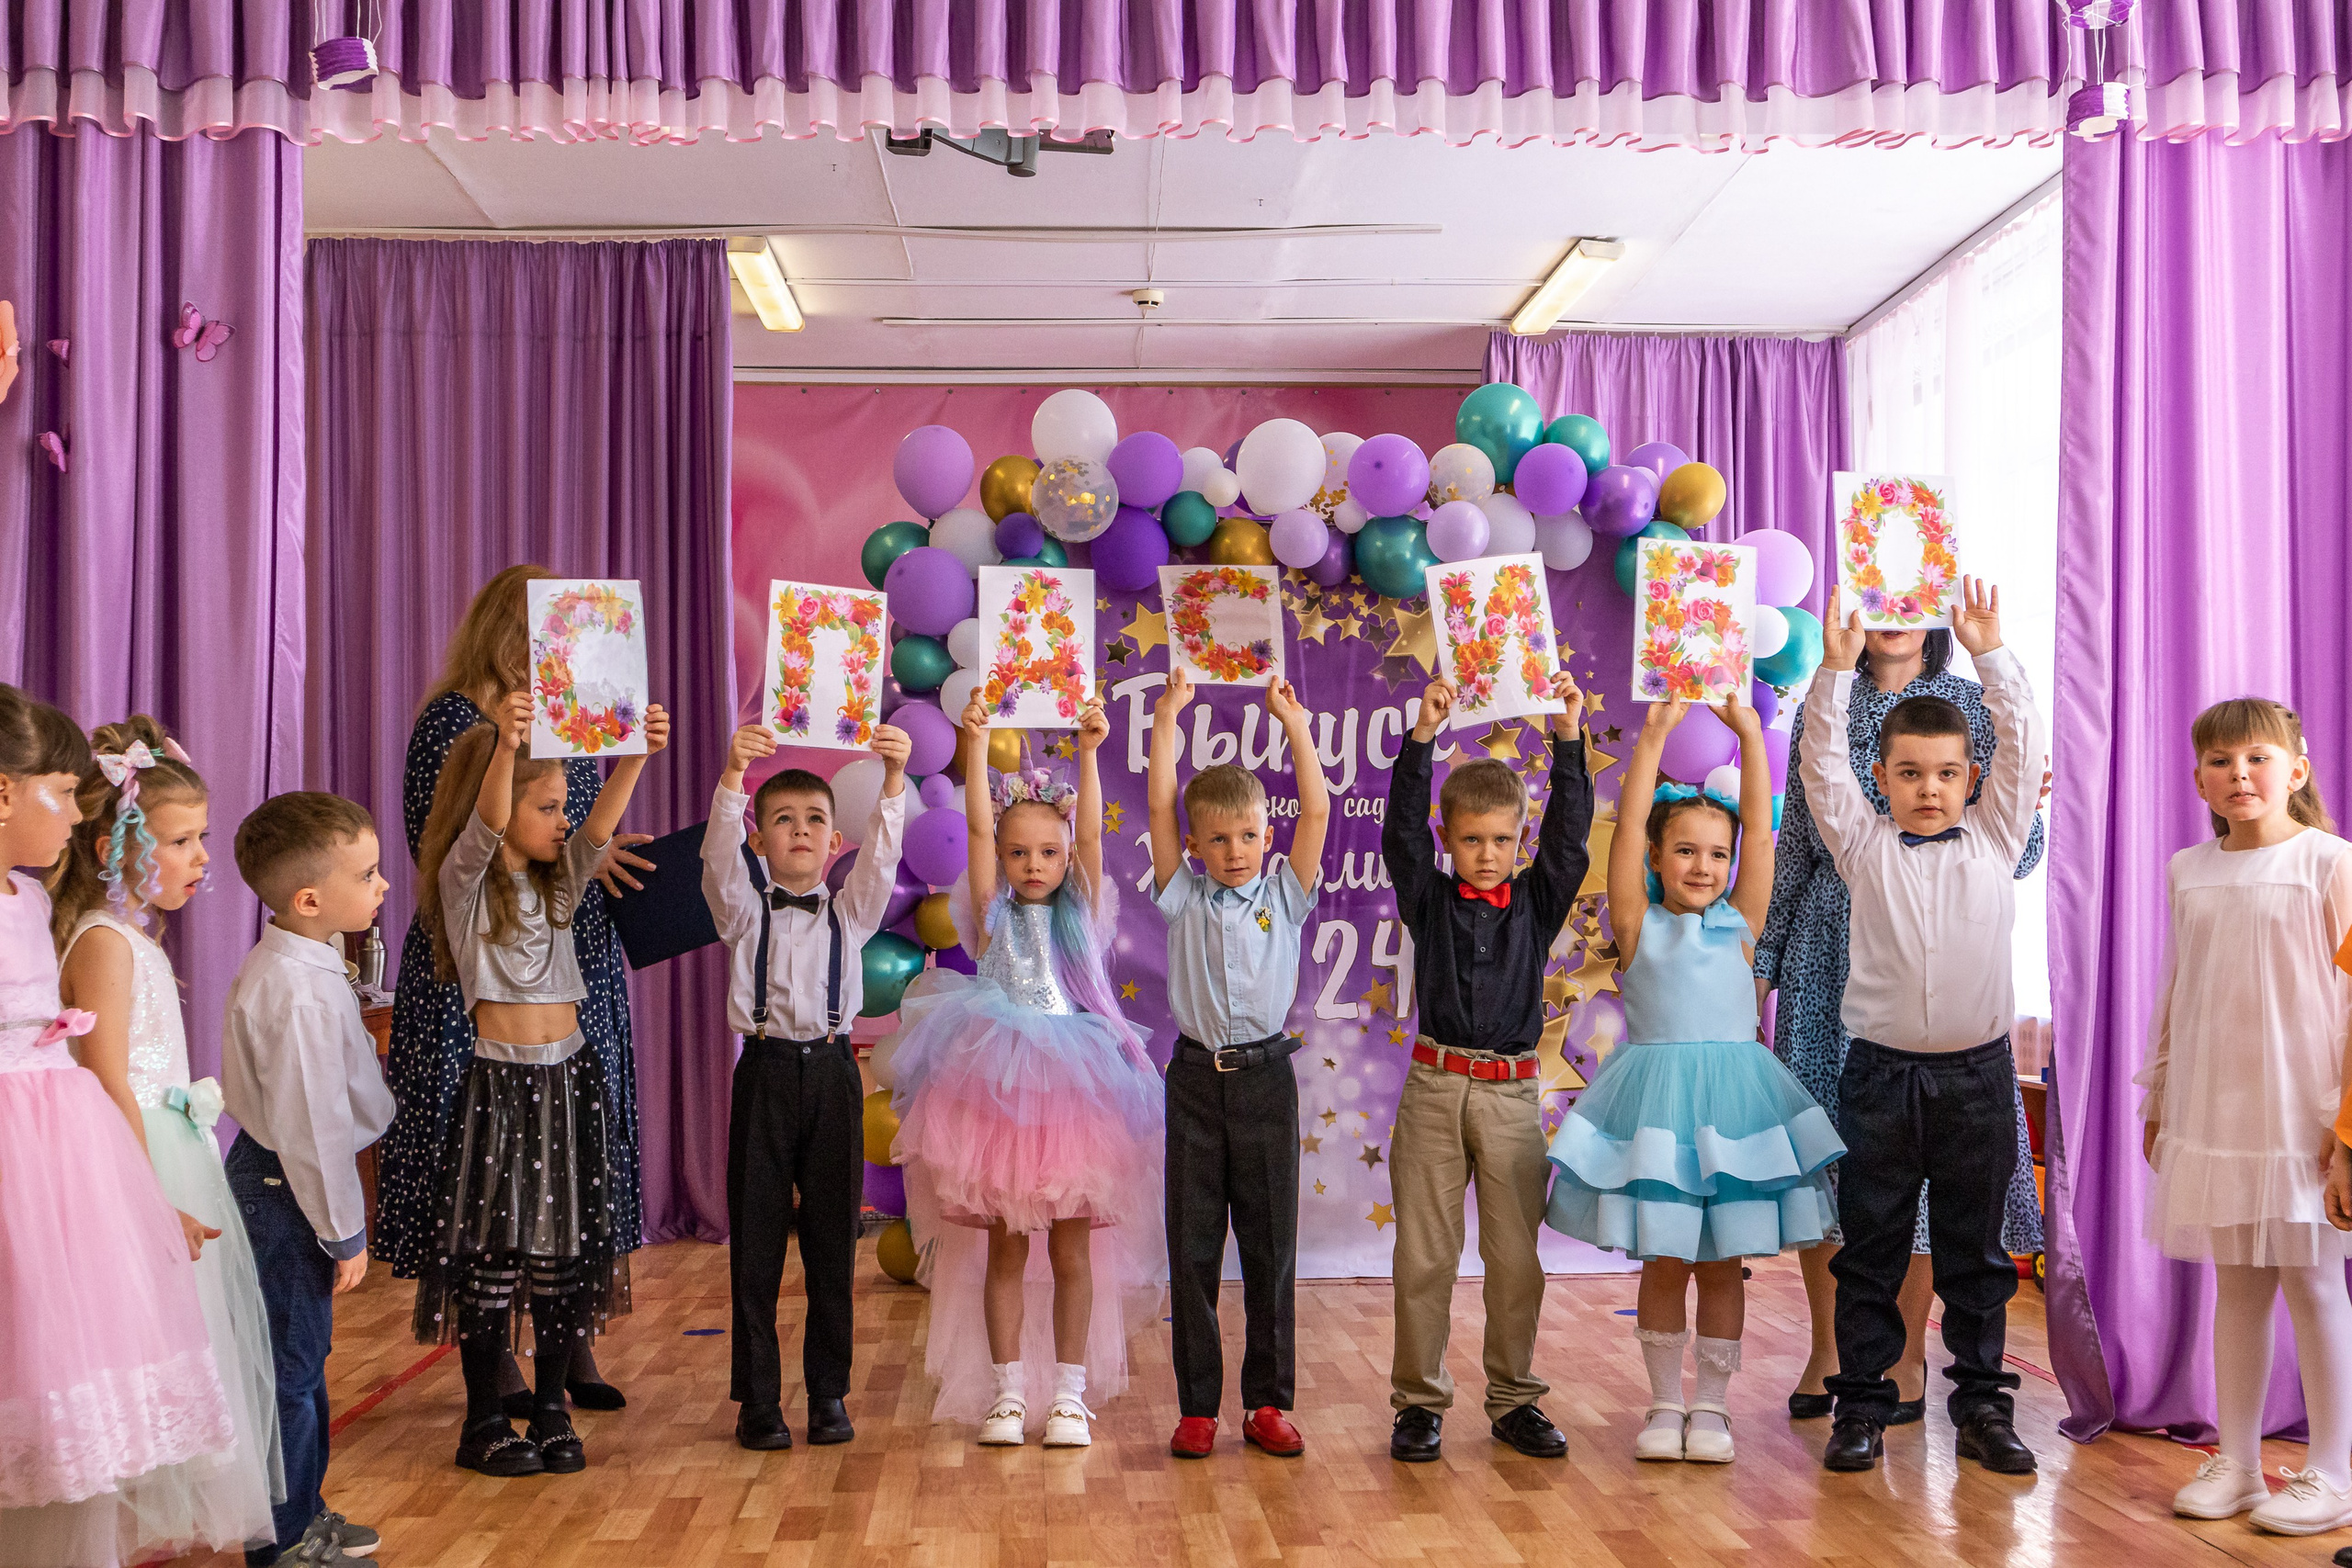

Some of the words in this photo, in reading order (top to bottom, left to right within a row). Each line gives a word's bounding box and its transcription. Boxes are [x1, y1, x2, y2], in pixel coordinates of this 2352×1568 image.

[1168, 567, 1277, 682] С
[1640, 541, 1747, 700] Б
[1840, 476, 1958, 626] О
[533, 582, 641, 753] С
[773, 584, 883, 747] П
[984, 570, 1088, 725] А
[1439, 562, 1555, 715] И
[1294, 919, 1416, 1021] 24
